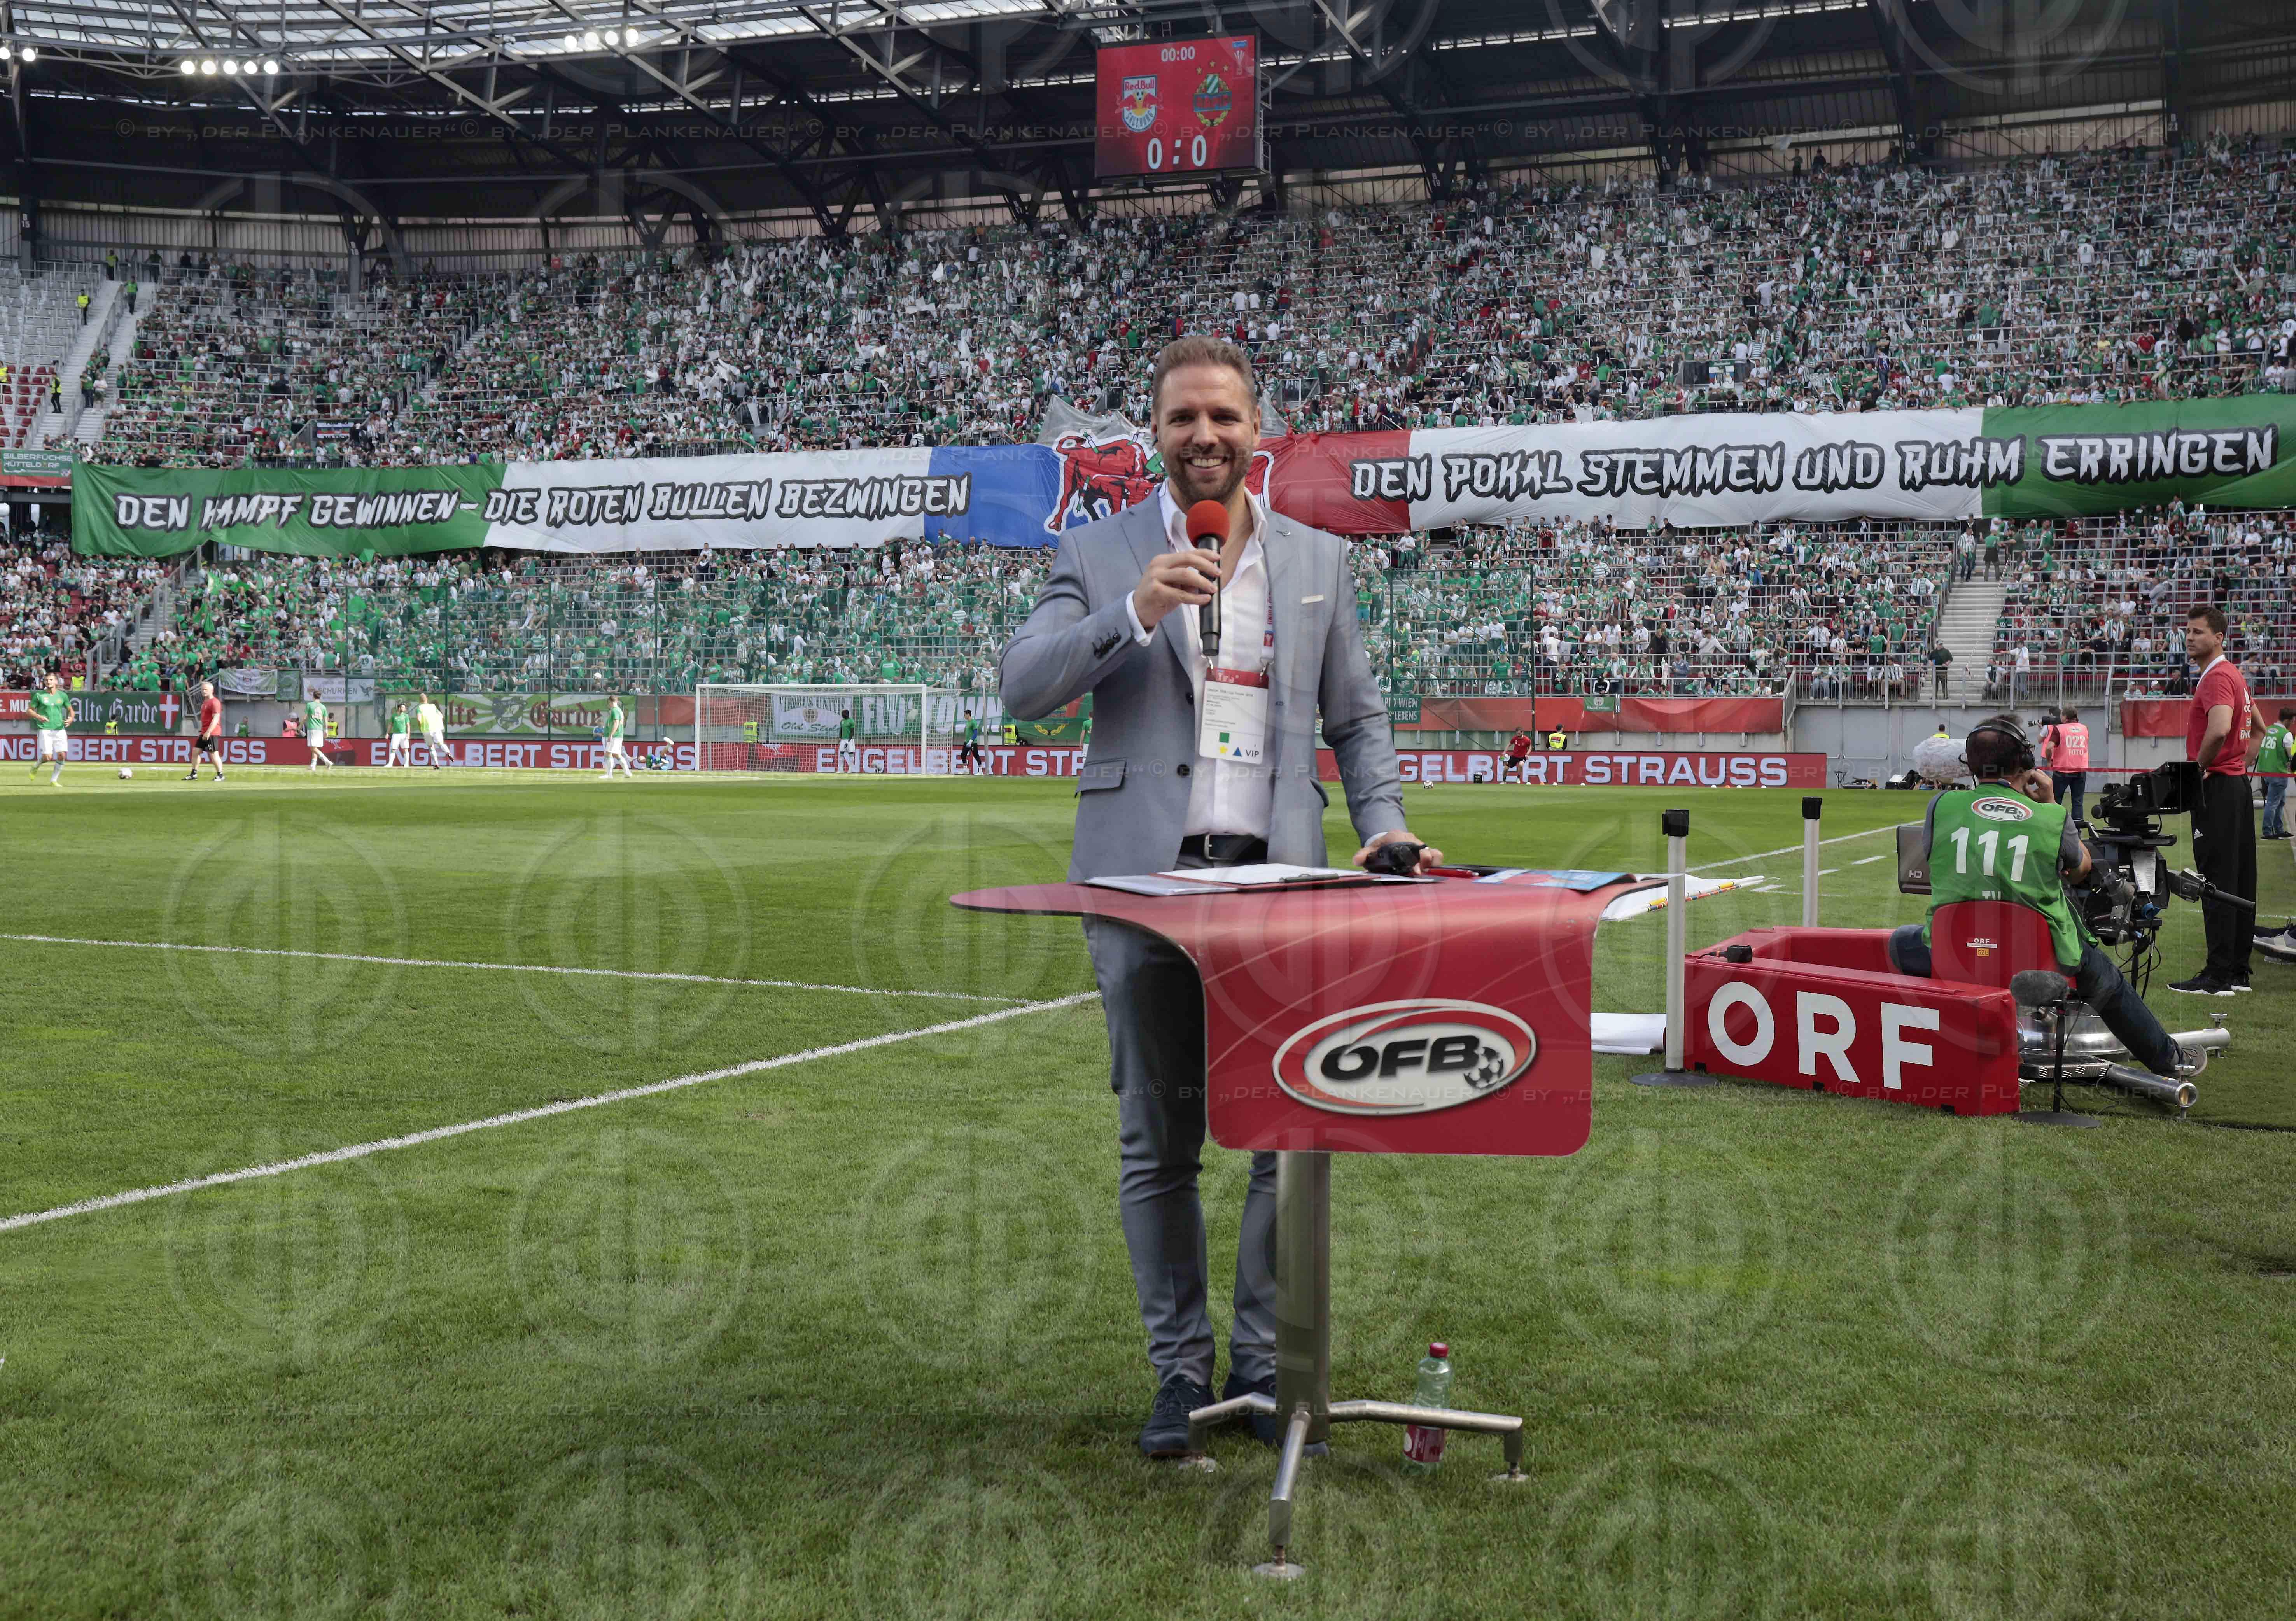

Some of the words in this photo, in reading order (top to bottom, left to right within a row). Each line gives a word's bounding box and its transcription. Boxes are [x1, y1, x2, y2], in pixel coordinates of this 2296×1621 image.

[1161, 46, 1195, 62] 00:00
[1353, 457, 1428, 498] DEN
[1446, 452, 1567, 498] POKAL
[1584, 446, 1783, 495] STEMMEN
[1799, 444, 1880, 490] UND
[1900, 439, 2023, 488] RUHM
[2042, 429, 2275, 481] ERRINGEN
[117, 495, 189, 529] DEN
[485, 491, 539, 524] DIE
[548, 485, 643, 525] ROTEN
[653, 482, 769, 520] BULLEN
[779, 475, 968, 518] BEZWINGEN
[10, 699, 31, 712] MU
[70, 697, 102, 723] Alte
[108, 697, 158, 724] Garde
[529, 700, 602, 728] Garde
[1398, 697, 1418, 708] WIEN
[2066, 735, 2085, 747] 022
[2261, 736, 2277, 749] 126
[1586, 756, 1787, 786] STRAUSS
[1951, 827, 2029, 881] 111
[1909, 870, 1922, 879] HD
[1708, 981, 1939, 1090] ORF
